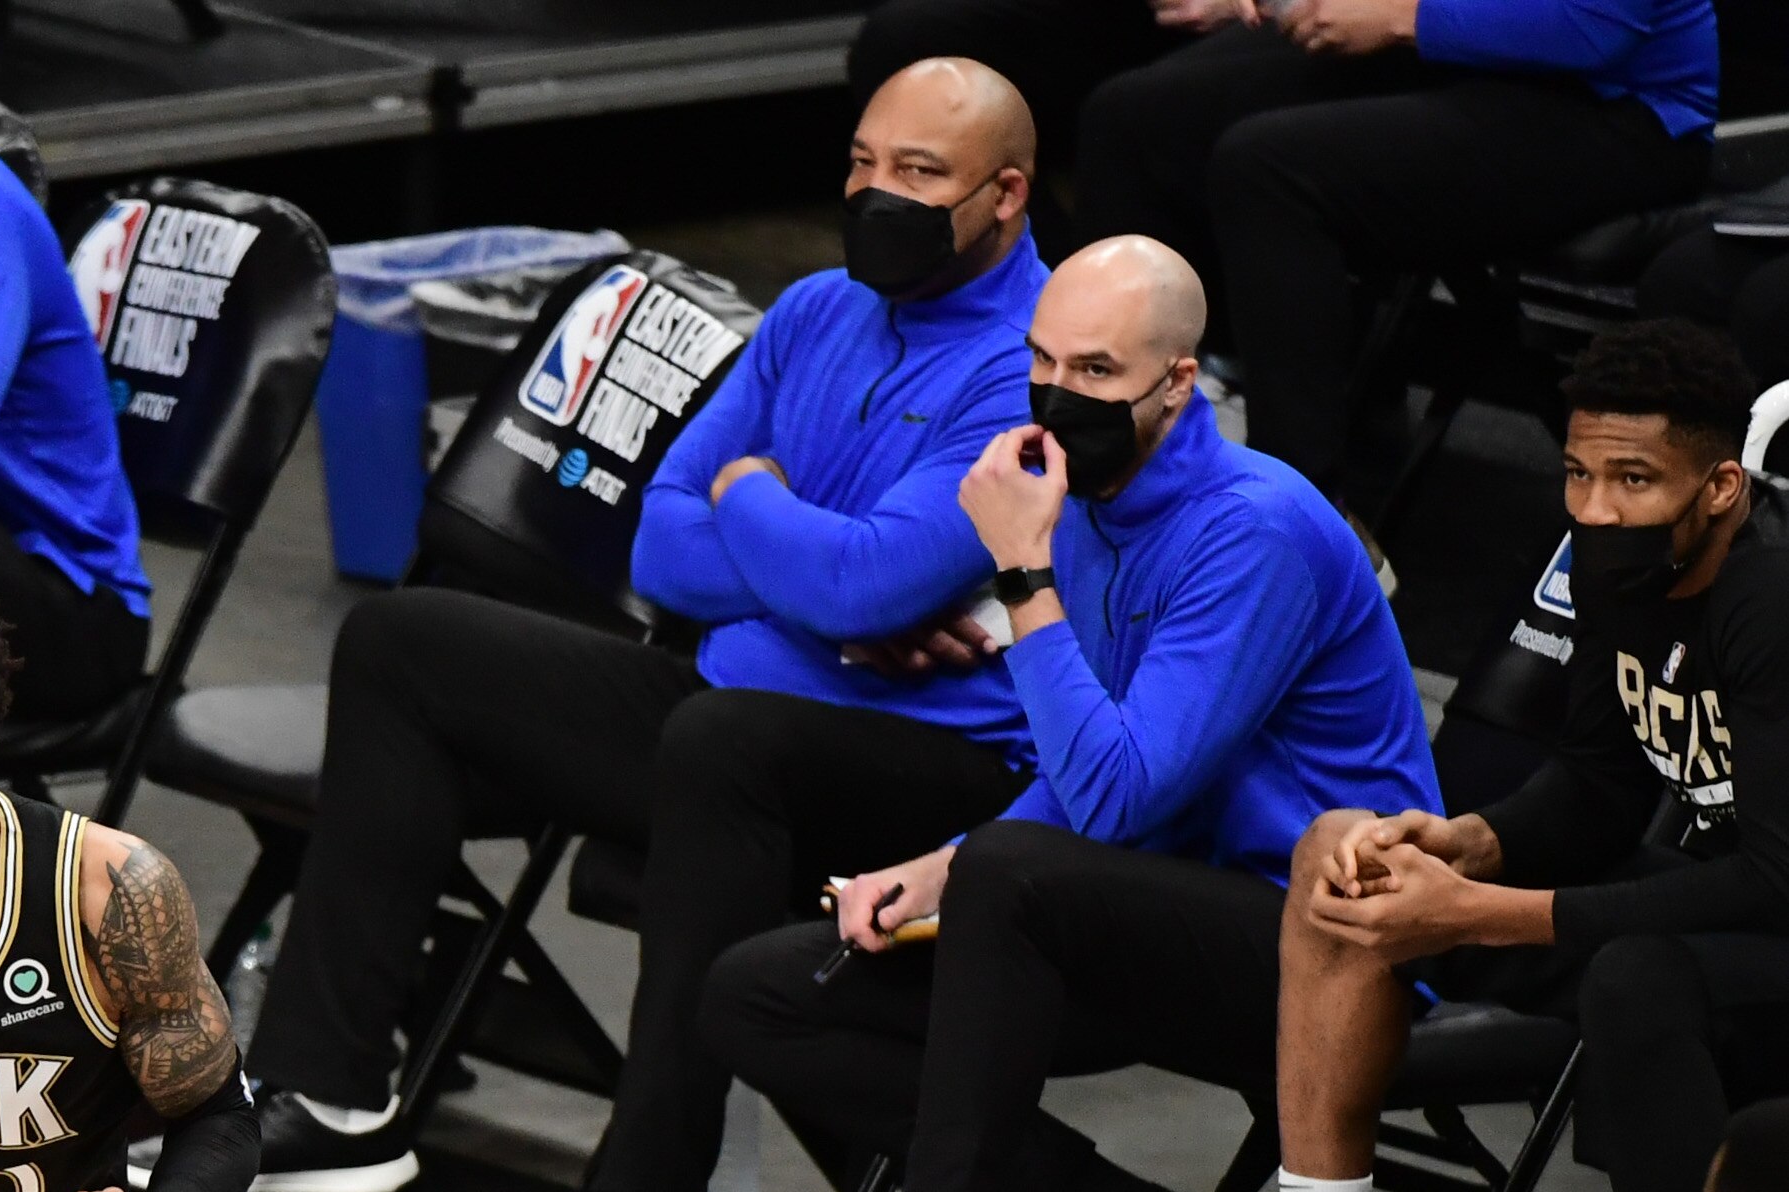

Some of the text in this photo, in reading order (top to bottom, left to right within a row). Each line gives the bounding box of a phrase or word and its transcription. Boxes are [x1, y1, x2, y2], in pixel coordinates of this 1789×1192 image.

[137, 204, 261, 279] EASTERN
[111, 305, 198, 379] FINALS
[625, 283, 745, 381] EASTERN
[605, 337, 702, 418] CONFERENCE
[576, 377, 660, 463] FINALS
[0, 998, 65, 1027] sharecare
